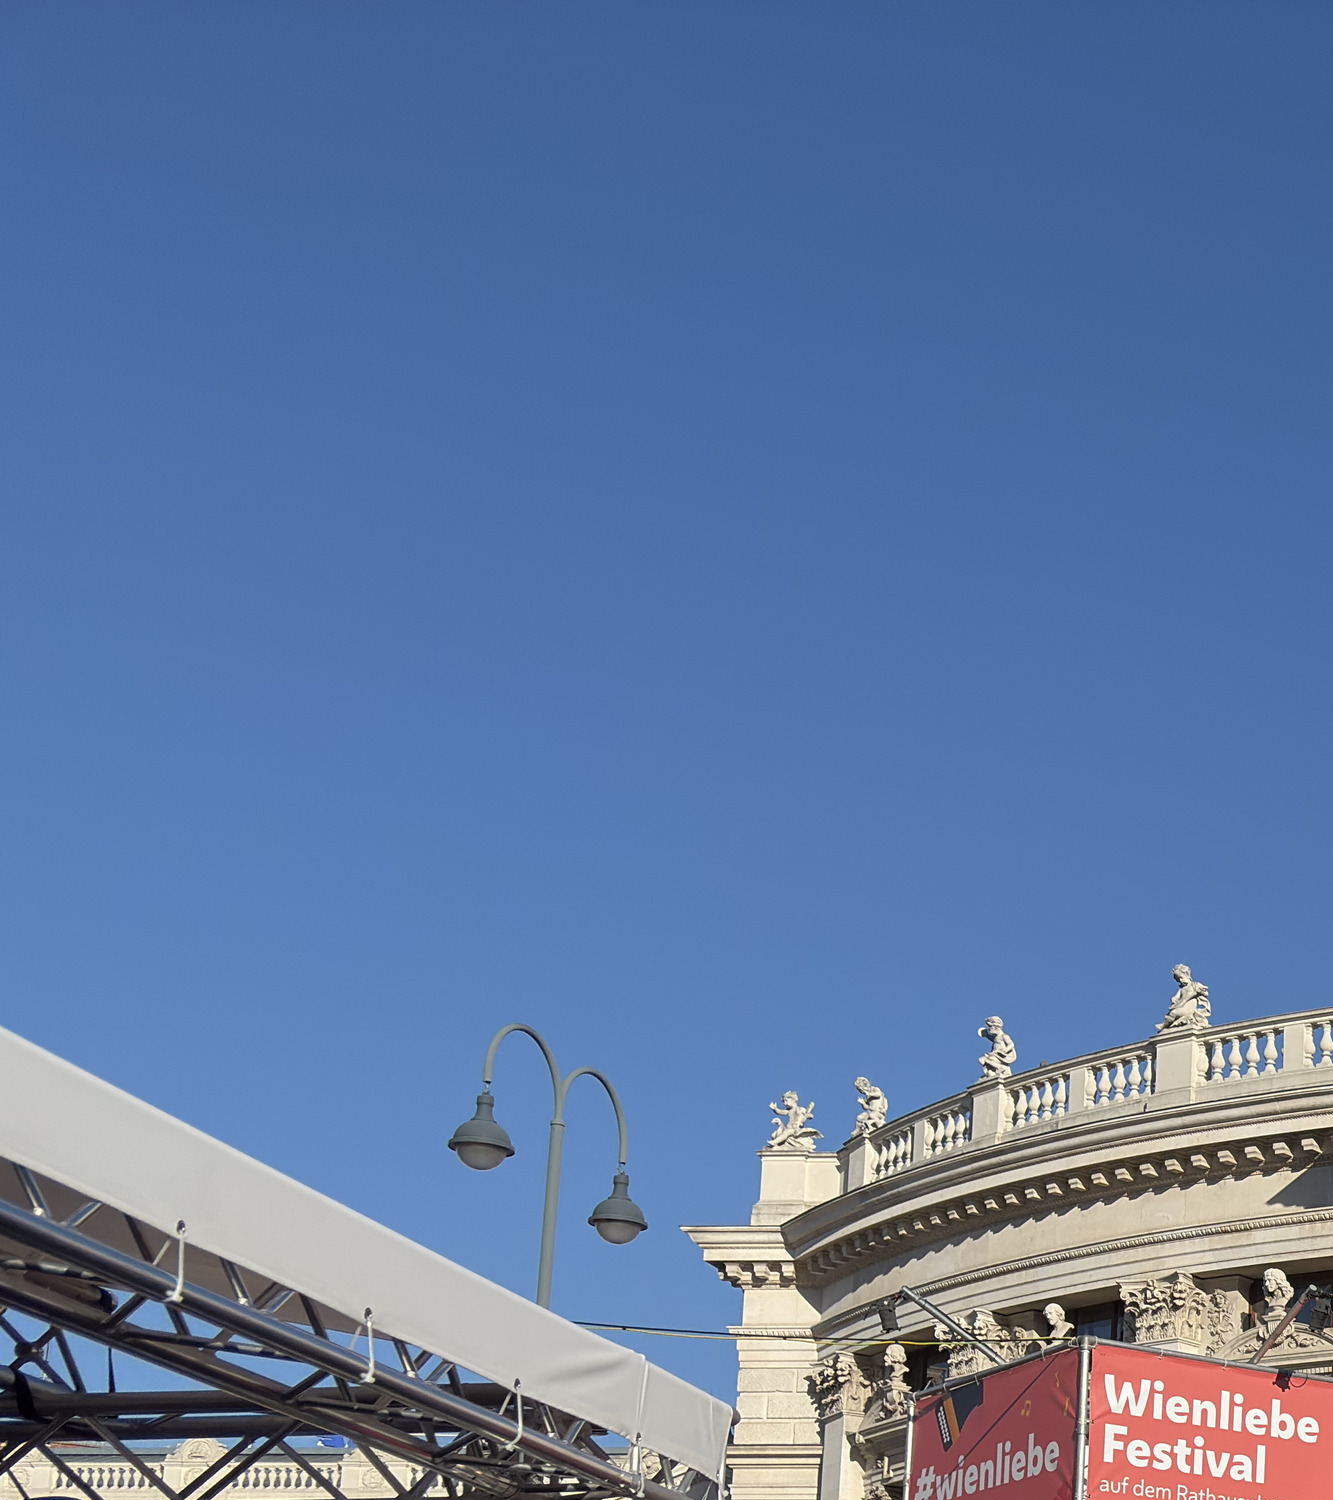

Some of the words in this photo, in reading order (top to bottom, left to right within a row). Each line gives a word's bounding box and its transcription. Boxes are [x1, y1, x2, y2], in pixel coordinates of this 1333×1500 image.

[1104, 1373, 1320, 1445] Wienliebe
[1102, 1424, 1267, 1484] Festival
[1099, 1477, 1128, 1495] auf
